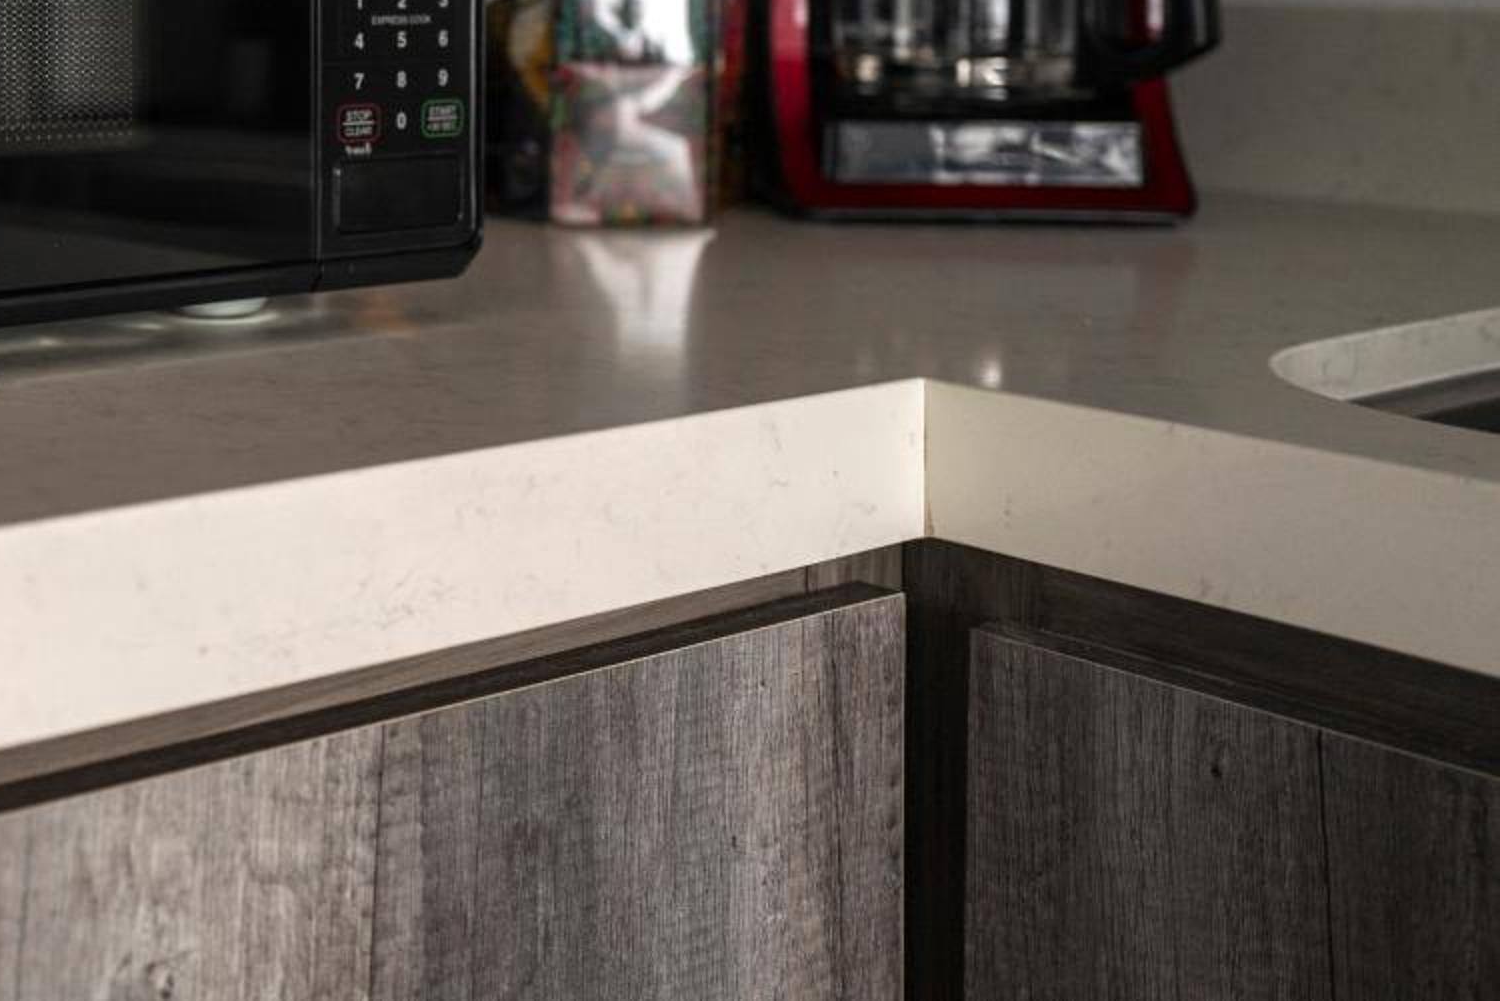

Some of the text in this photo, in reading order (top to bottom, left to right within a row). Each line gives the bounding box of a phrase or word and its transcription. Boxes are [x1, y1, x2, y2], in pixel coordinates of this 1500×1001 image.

[354, 32, 365, 50] 4
[397, 30, 407, 49] 5
[438, 29, 449, 48] 6
[353, 72, 365, 90] 7
[397, 70, 408, 89] 8
[438, 68, 449, 87] 9
[345, 109, 373, 122] STOP
[396, 111, 407, 130] 0
[345, 125, 373, 137] CLEAR
